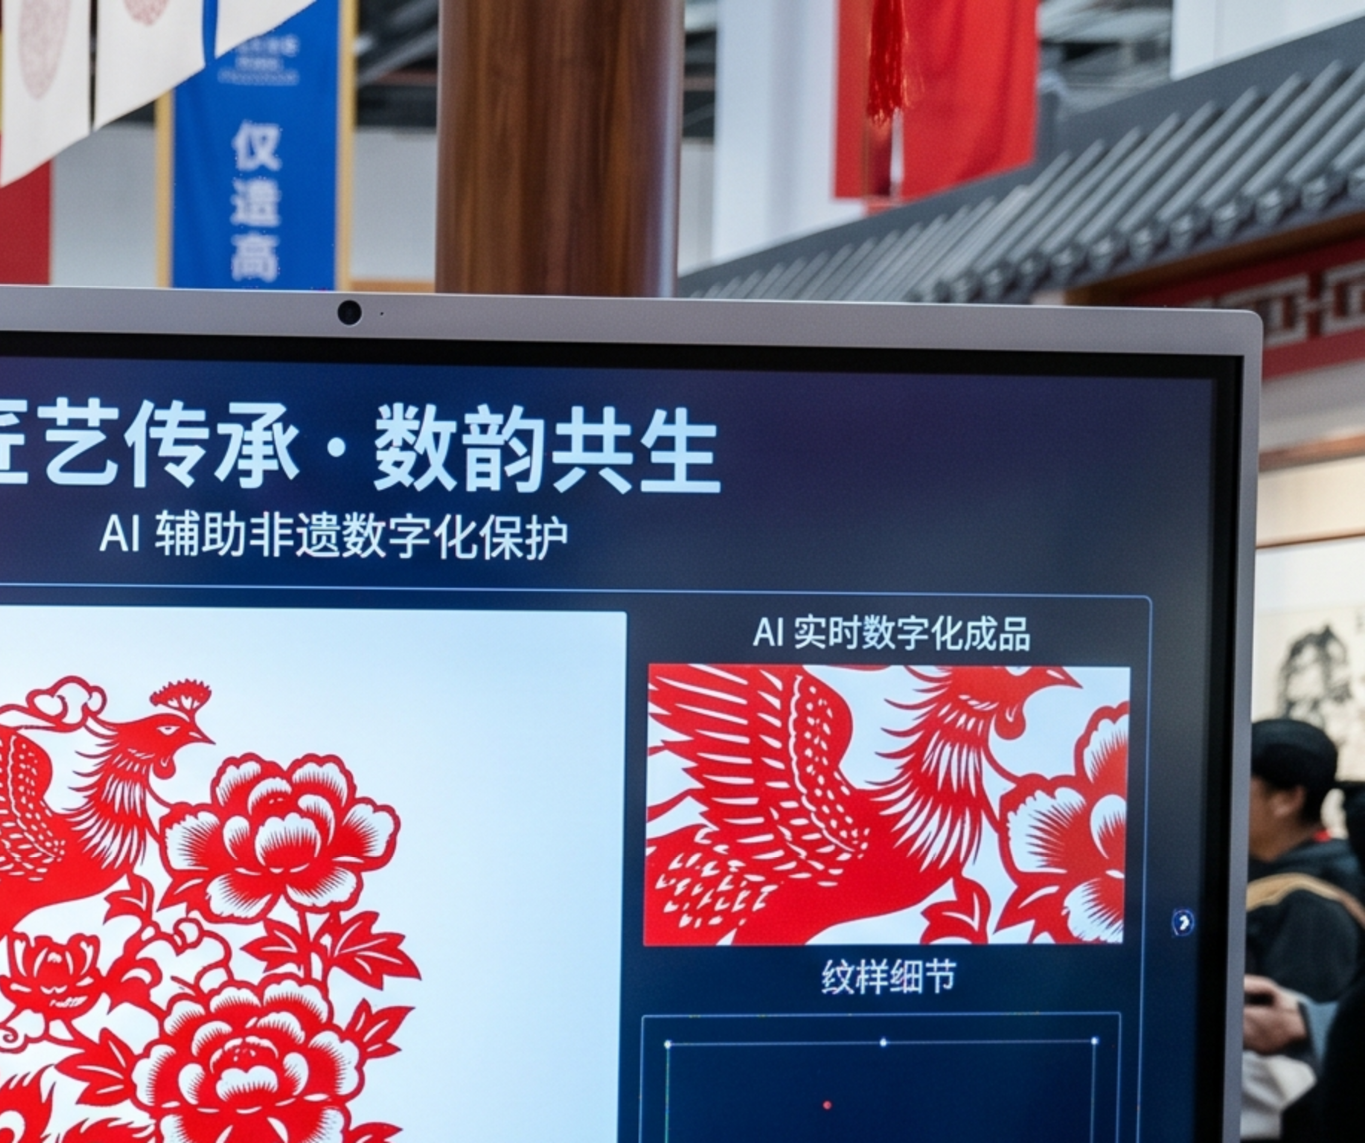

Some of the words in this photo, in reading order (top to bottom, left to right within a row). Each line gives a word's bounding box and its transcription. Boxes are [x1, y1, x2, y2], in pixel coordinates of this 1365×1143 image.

[99, 514, 140, 553] AI
[154, 509, 569, 561] 辅助非遗数字化保护
[752, 617, 784, 647] AI
[794, 613, 1031, 652] 实时数字化成品
[821, 957, 957, 995] 纹样细节
